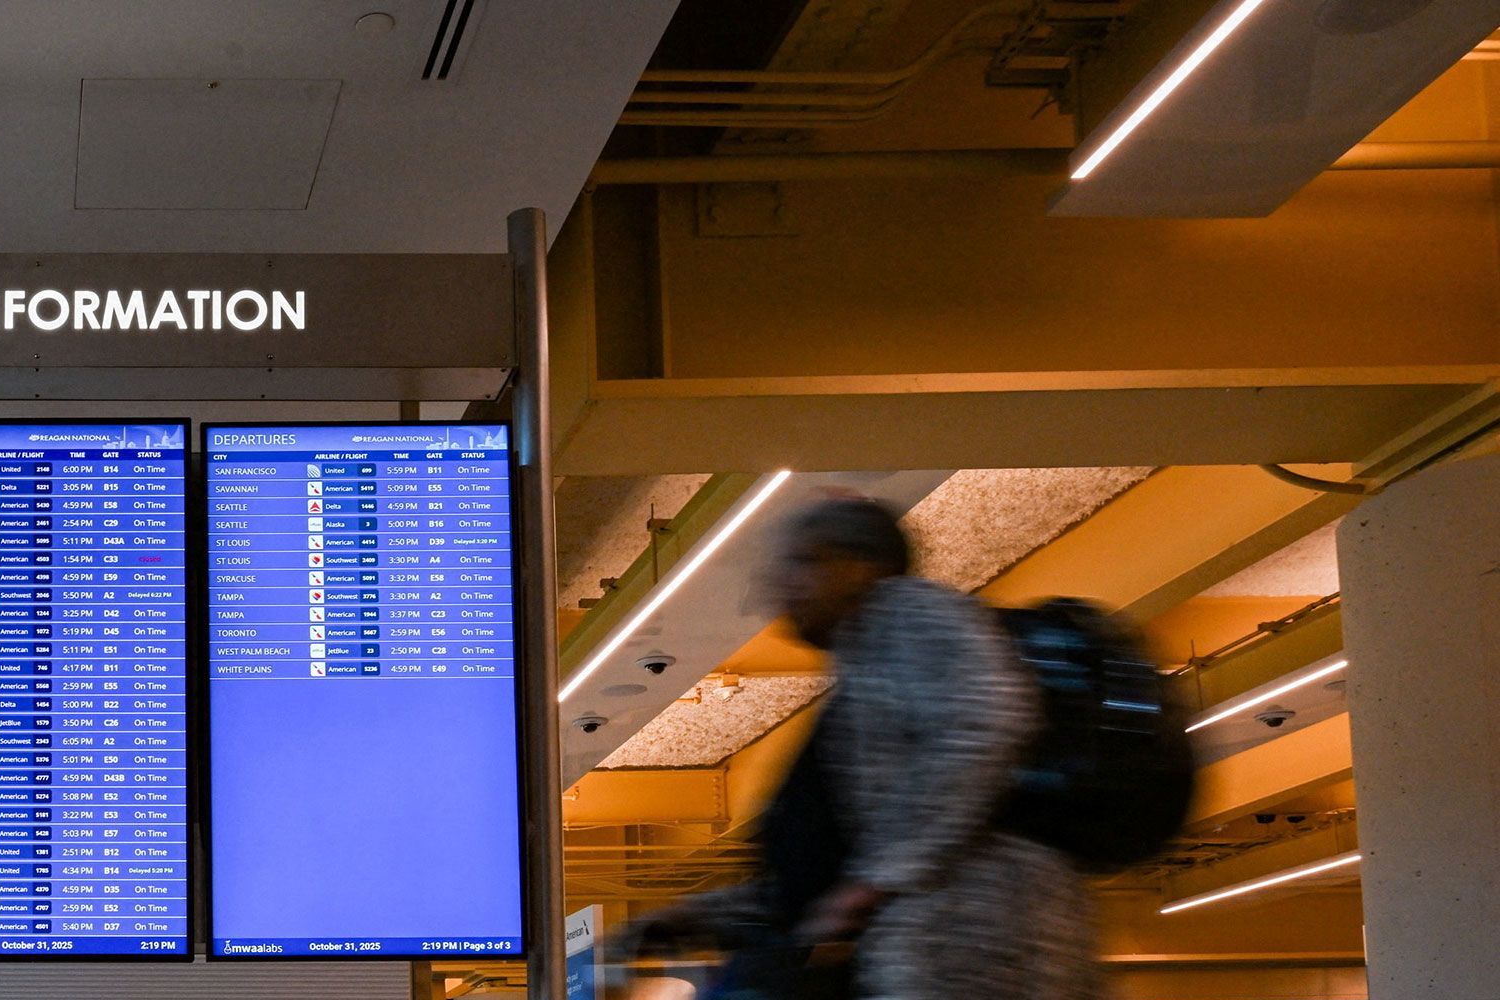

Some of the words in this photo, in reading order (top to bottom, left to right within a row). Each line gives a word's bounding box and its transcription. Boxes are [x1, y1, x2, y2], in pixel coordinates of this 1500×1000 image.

[39, 434, 71, 442] REAGAN
[72, 434, 111, 442] NATIONAL
[214, 434, 297, 446] DEPARTURES
[21, 451, 45, 459] FLIGHT
[69, 451, 86, 459] TIME
[102, 451, 119, 459] GATE
[137, 450, 162, 458] STATUS
[213, 453, 228, 461] CITY
[314, 452, 342, 460] AIRLINE
[345, 452, 368, 460] FLIGHT
[393, 452, 409, 460] TIME
[426, 451, 443, 459] GATE
[461, 451, 485, 459] STATUS
[232, 467, 277, 475] FRANCISCO
[215, 485, 258, 493] SAVANNAH
[387, 484, 404, 492] 5:09
[428, 484, 442, 492] E55
[215, 503, 248, 511] SEATTLE
[63, 519, 80, 527] 2:54
[80, 519, 93, 527] PM
[103, 519, 119, 527] C29
[133, 519, 146, 527] On
[146, 519, 166, 527] Time
[216, 539, 225, 547] ST
[227, 539, 251, 547] LOUIS
[216, 575, 256, 583] SYRACUSE
[217, 593, 245, 601] TAMPA
[217, 629, 257, 637] TORONTO
[263, 647, 290, 655] BEACH
[217, 666, 243, 674] WHITE
[63, 682, 80, 690] 2:59
[80, 682, 93, 690] PM
[103, 682, 118, 690] E55
[134, 682, 146, 690] On
[147, 682, 167, 690] Time
[1, 940, 35, 950] October
[37, 940, 51, 951] 31,
[51, 940, 73, 950] 2025
[140, 940, 161, 950] 2:19
[163, 940, 176, 950] PM
[232, 942, 283, 953] mwaalabs
[308, 941, 343, 951] October
[345, 942, 358, 952] 31,
[360, 941, 381, 951] 2025
[422, 941, 442, 950] 2:19
[443, 941, 458, 950] PM
[463, 941, 486, 952] Page
[493, 940, 503, 950] of
